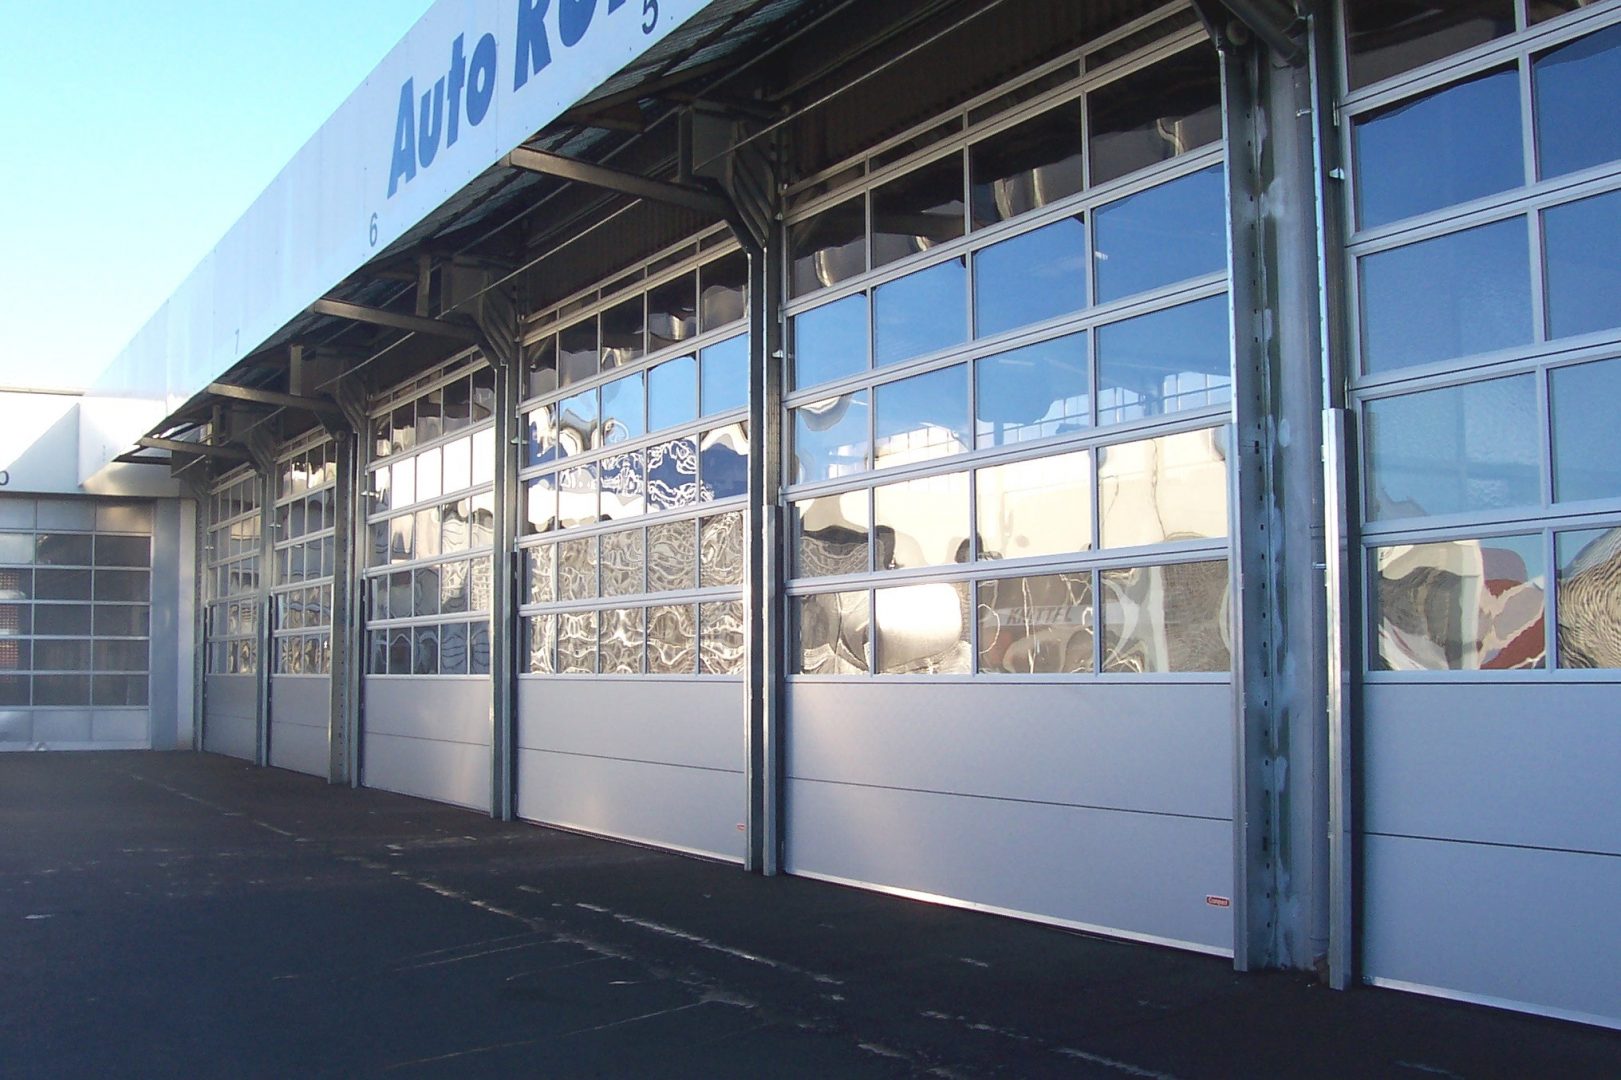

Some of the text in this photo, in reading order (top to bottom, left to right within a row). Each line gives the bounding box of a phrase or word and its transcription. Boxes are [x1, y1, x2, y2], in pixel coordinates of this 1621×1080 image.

[642, 0, 659, 35] 5
[387, 32, 497, 199] Auto
[369, 212, 379, 247] 6
